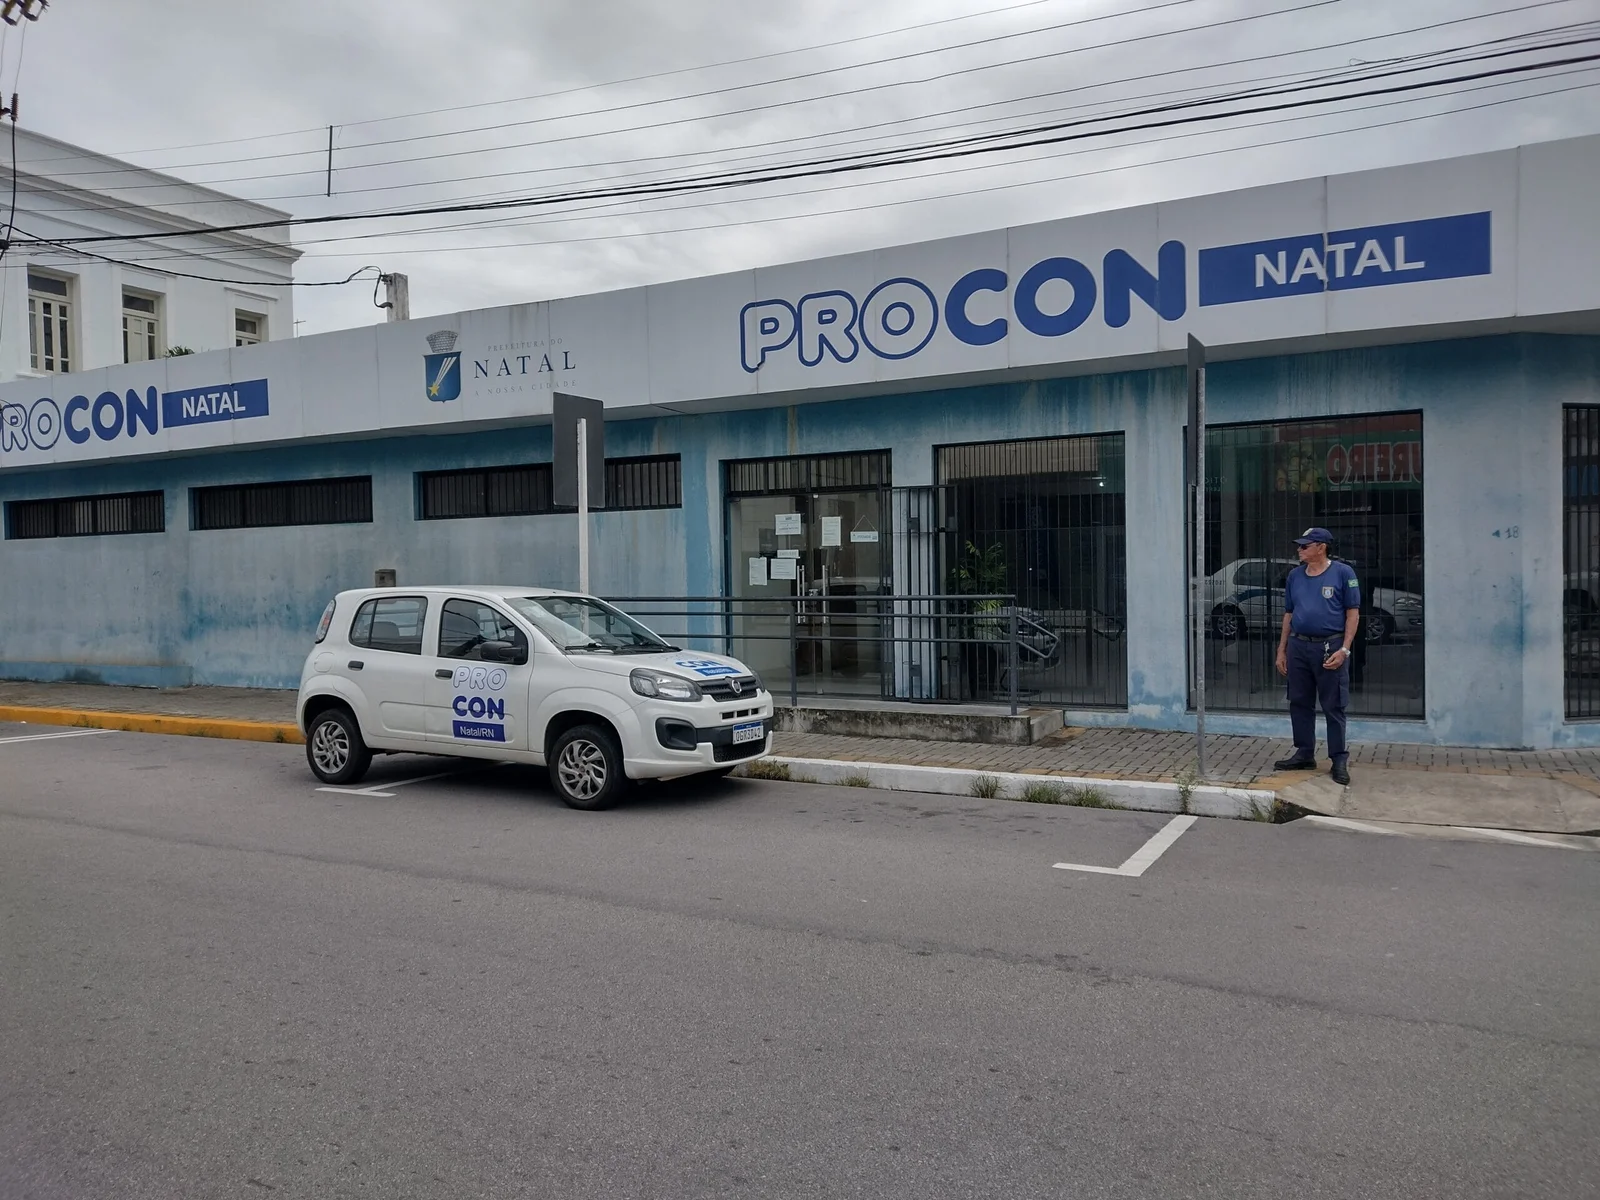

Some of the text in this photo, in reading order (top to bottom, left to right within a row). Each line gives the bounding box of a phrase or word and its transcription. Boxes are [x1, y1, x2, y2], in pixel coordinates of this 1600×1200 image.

[740, 235, 1425, 373] PROCON NATAL
[487, 338, 563, 352] PREFEITURA DO
[474, 350, 576, 379] NATAL
[487, 385, 523, 395] NOSSA
[531, 380, 577, 391] CIDADE
[0, 385, 246, 453] ROCON NATAL
[453, 666, 507, 691] PRO
[452, 695, 505, 720] CON
[460, 726, 495, 738] Natal/RN
